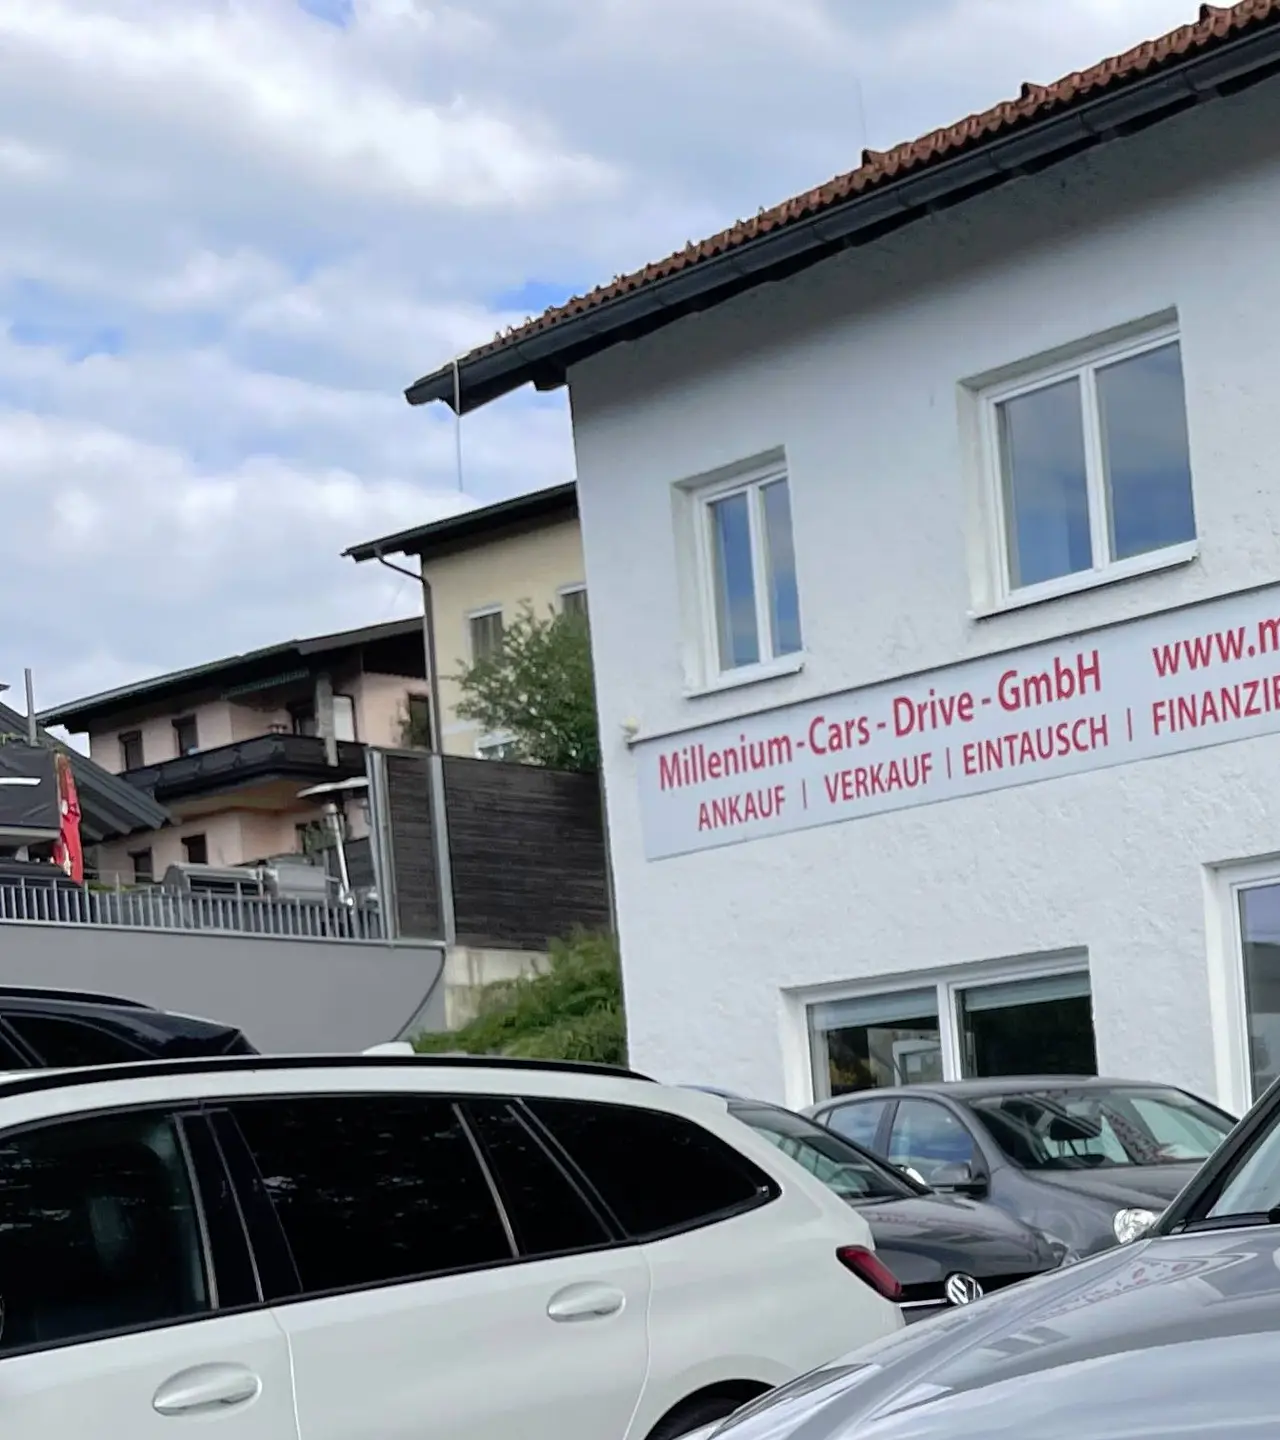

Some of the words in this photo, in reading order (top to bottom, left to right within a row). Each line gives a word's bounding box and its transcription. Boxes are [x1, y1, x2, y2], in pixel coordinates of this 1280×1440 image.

[698, 785, 786, 831] ANKAUF
[824, 753, 934, 804] VERKAUF
[963, 714, 1109, 776] EINTAUSCH
